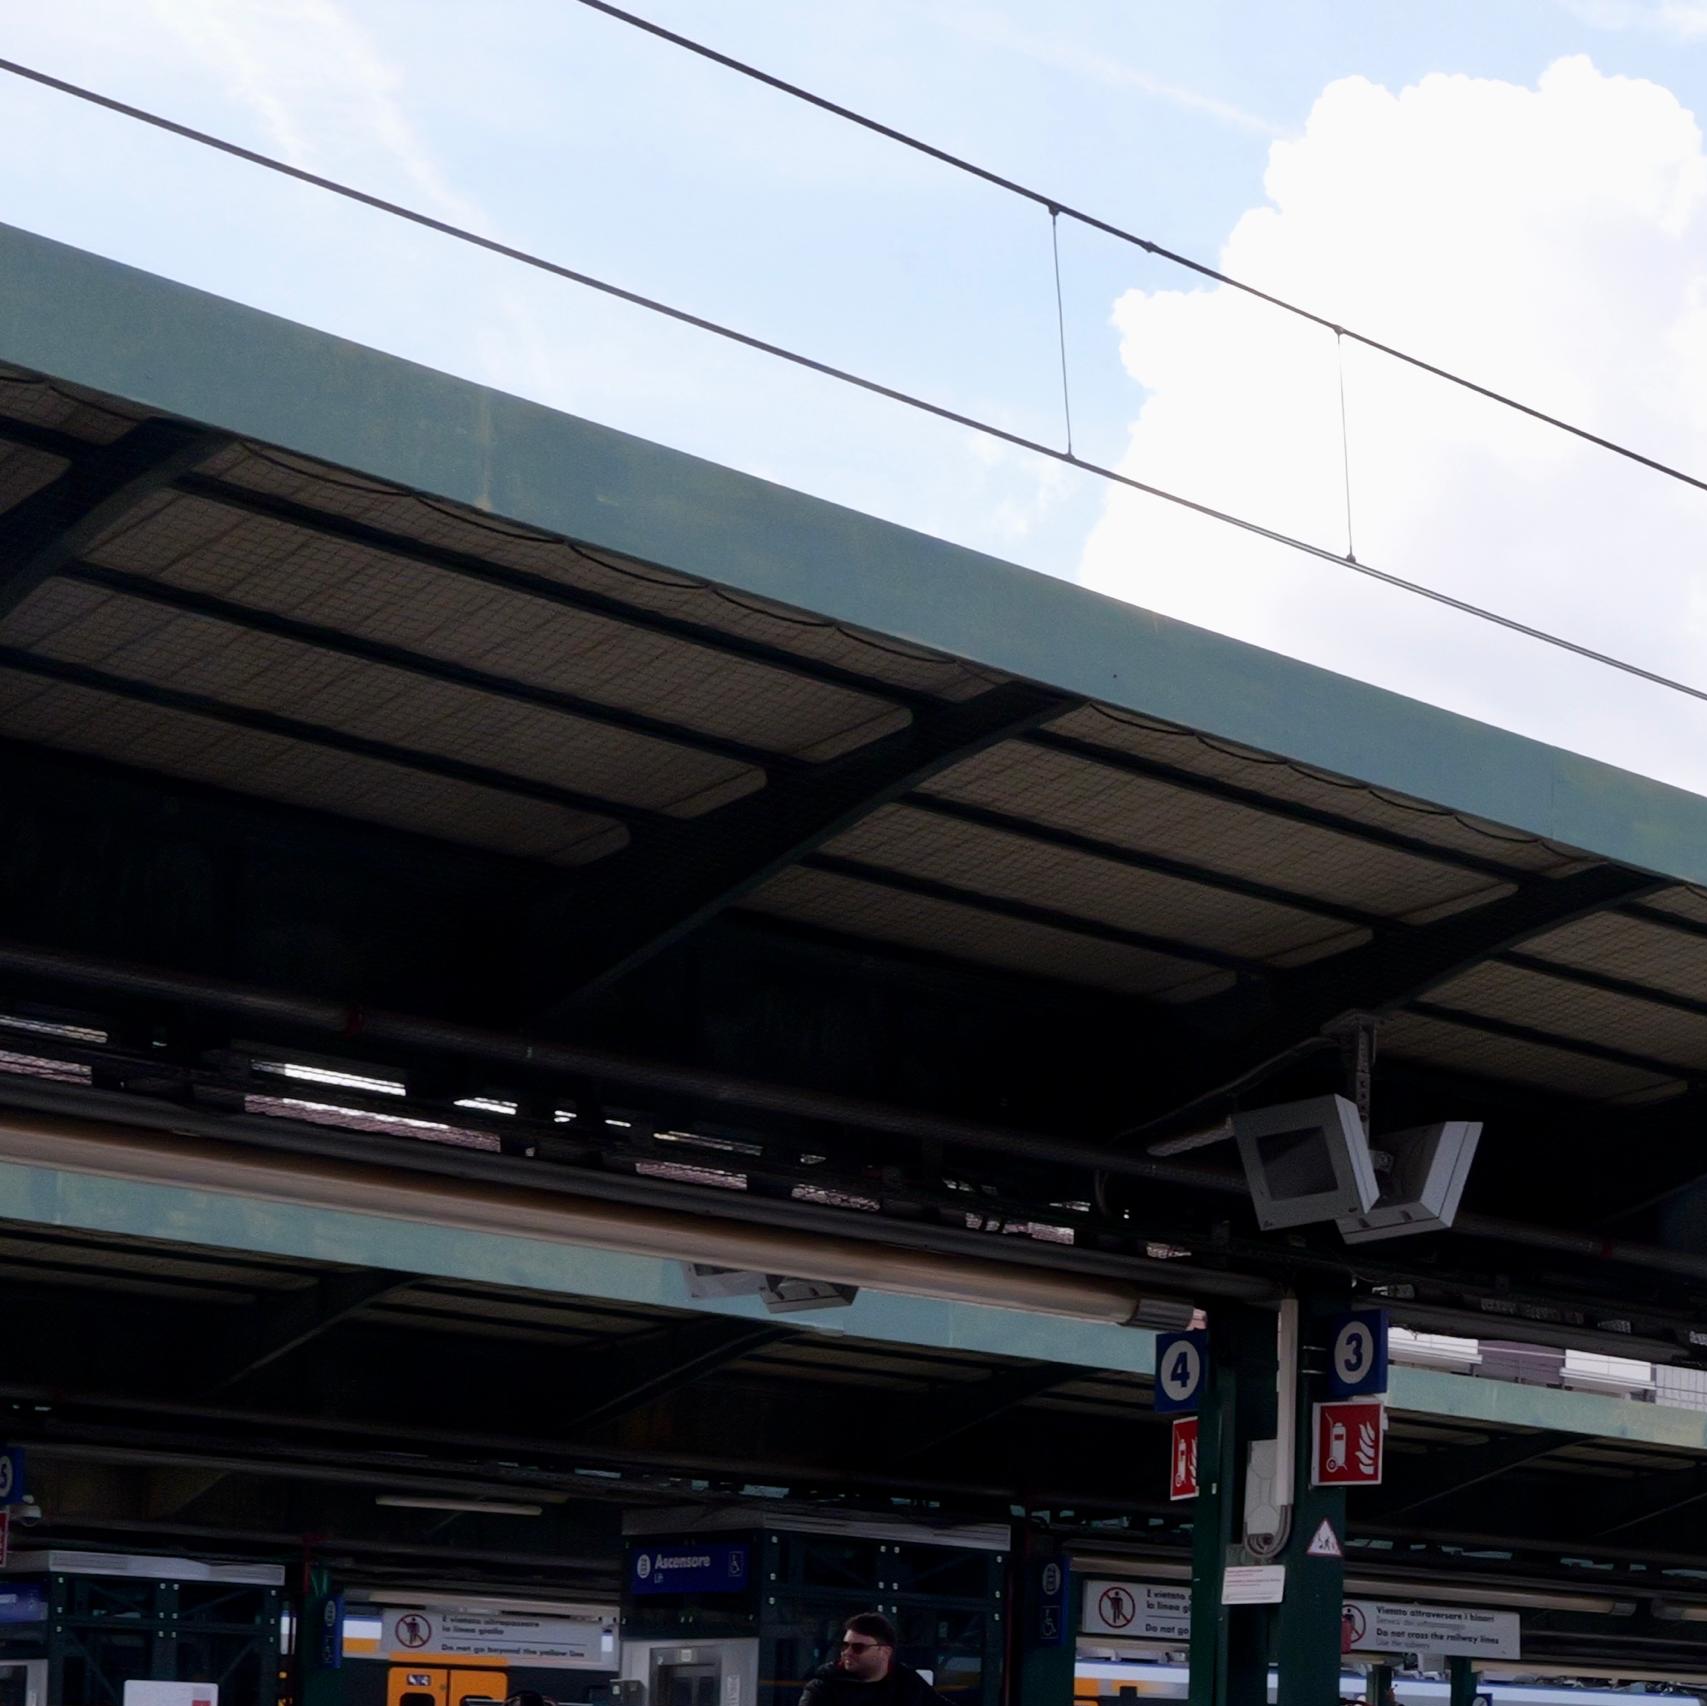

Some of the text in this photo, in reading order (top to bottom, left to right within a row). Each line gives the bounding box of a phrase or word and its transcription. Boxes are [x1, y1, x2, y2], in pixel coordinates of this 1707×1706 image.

[1344, 1333, 1364, 1372] 3
[1170, 1352, 1191, 1388] 4
[655, 1553, 711, 1570] Ascensore
[1376, 1605, 1408, 1617] Vietato
[1410, 1608, 1462, 1620] attraversare
[1145, 1624, 1189, 1637] Do not go
[1376, 1628, 1499, 1645] Do not cross the railway lines
